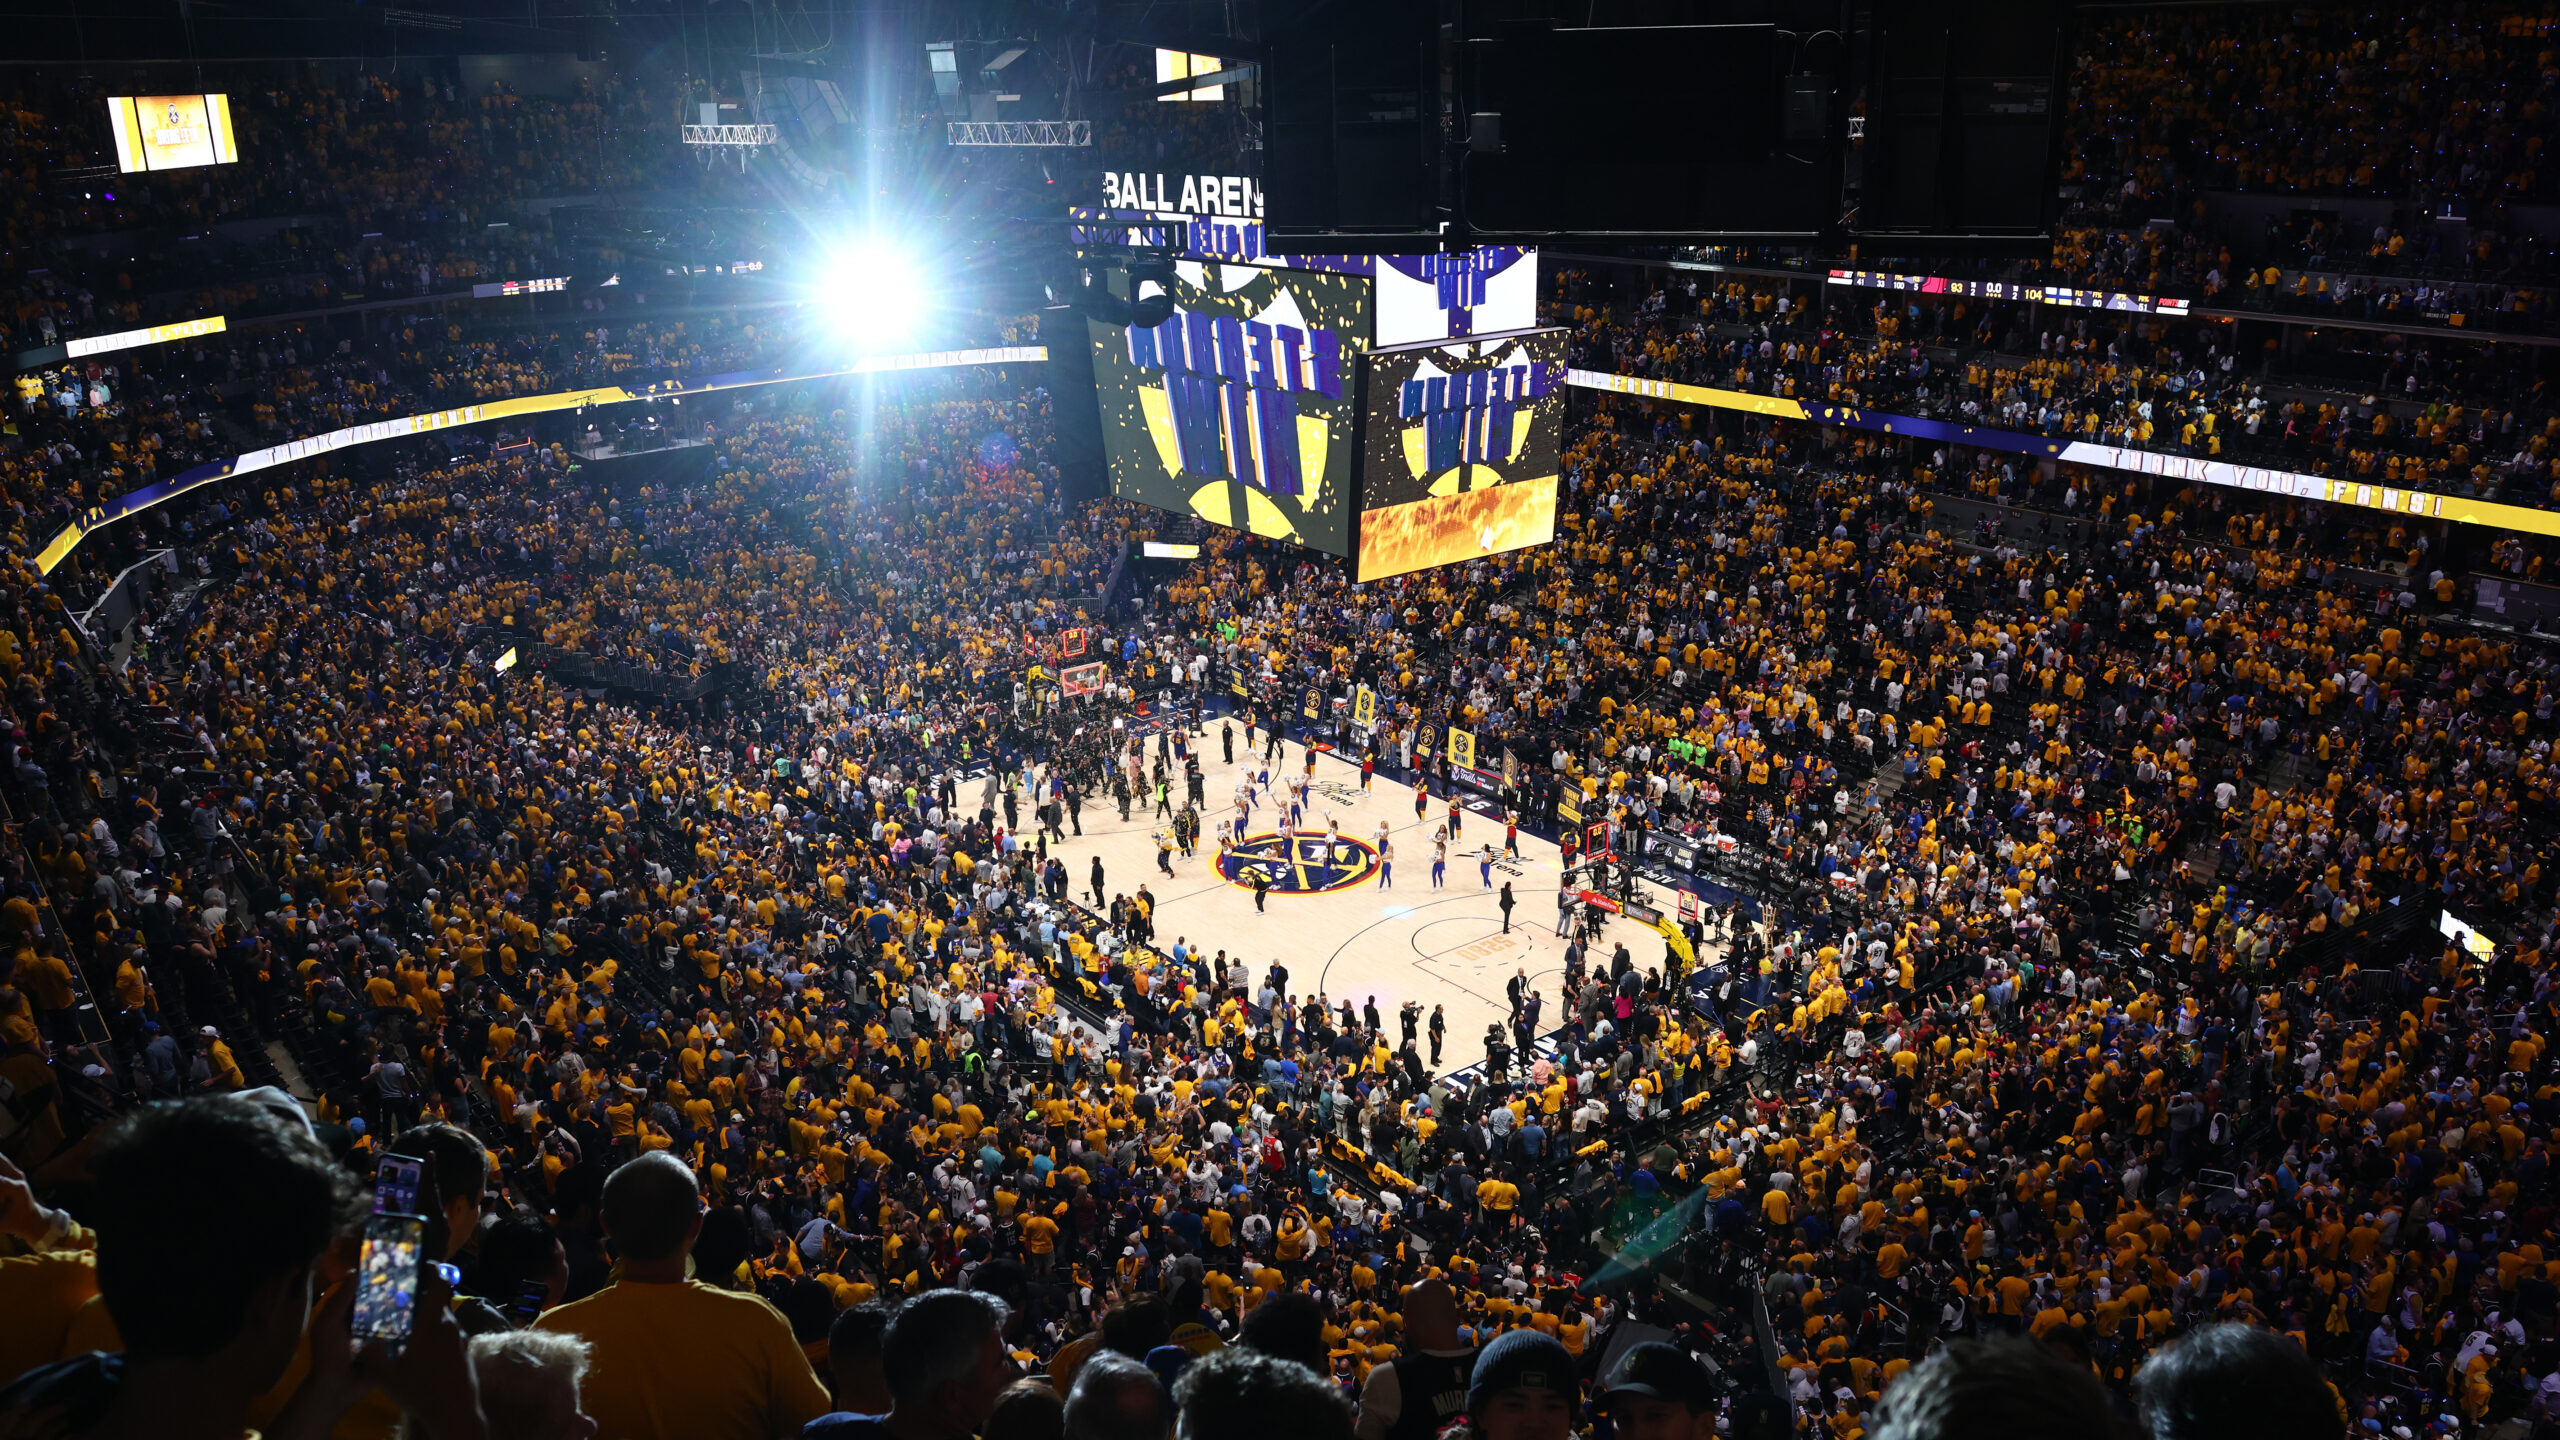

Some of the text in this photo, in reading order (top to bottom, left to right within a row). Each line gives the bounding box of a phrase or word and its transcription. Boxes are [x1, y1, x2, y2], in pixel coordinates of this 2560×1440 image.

[1102, 172, 1264, 217] BALL AREN
[1876, 280, 1885, 288] 33
[1893, 281, 1905, 290] 100
[1950, 282, 1964, 293] 93
[1986, 282, 2003, 294] 0.0
[2024, 289, 2043, 301] 104
[2117, 301, 2127, 310] 30
[1614, 374, 1674, 399] FANS!
[266, 405, 485, 464] THANK YOU, FANS!
[1162, 371, 1304, 496] WIN
[1423, 401, 1517, 473] WIN
[2108, 448, 2443, 517] THANK YOU, FANS!
[1453, 752, 1469, 766] WIN!
[1563, 786, 1580, 802] THANK
[1565, 797, 1576, 810] YOU
[827, 944, 836, 953] 27
[1226, 1040, 1234, 1049] 27
[1618, 1090, 1626, 1102] 15
[1108, 1225, 1116, 1237] 15
[1432, 1390, 1469, 1416] MUR
